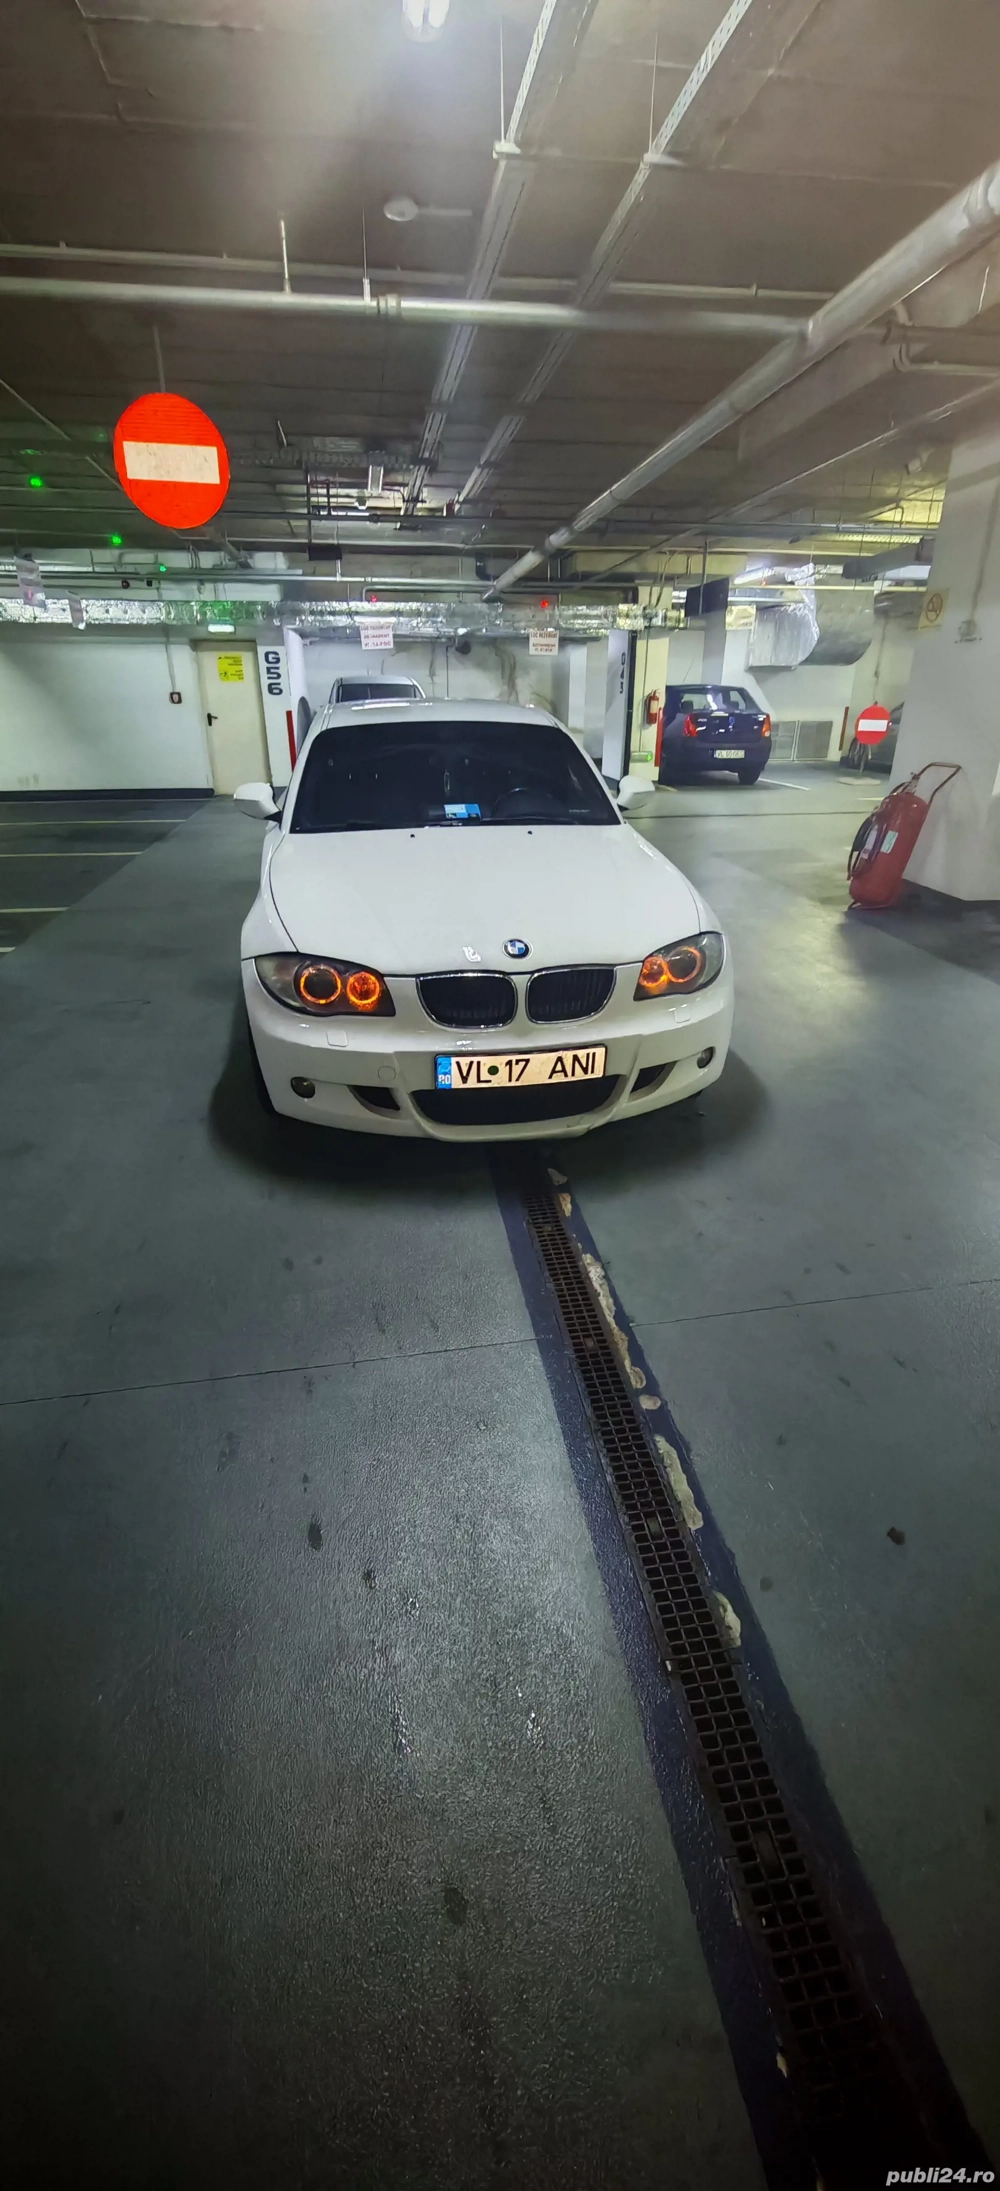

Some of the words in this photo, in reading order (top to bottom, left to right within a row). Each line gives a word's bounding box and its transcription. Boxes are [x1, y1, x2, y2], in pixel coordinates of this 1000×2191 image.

[264, 651, 284, 696] G56
[438, 1074, 451, 1085] RO
[455, 1060, 492, 1084] VL
[505, 1058, 531, 1083] 17
[548, 1051, 597, 1080] ANI
